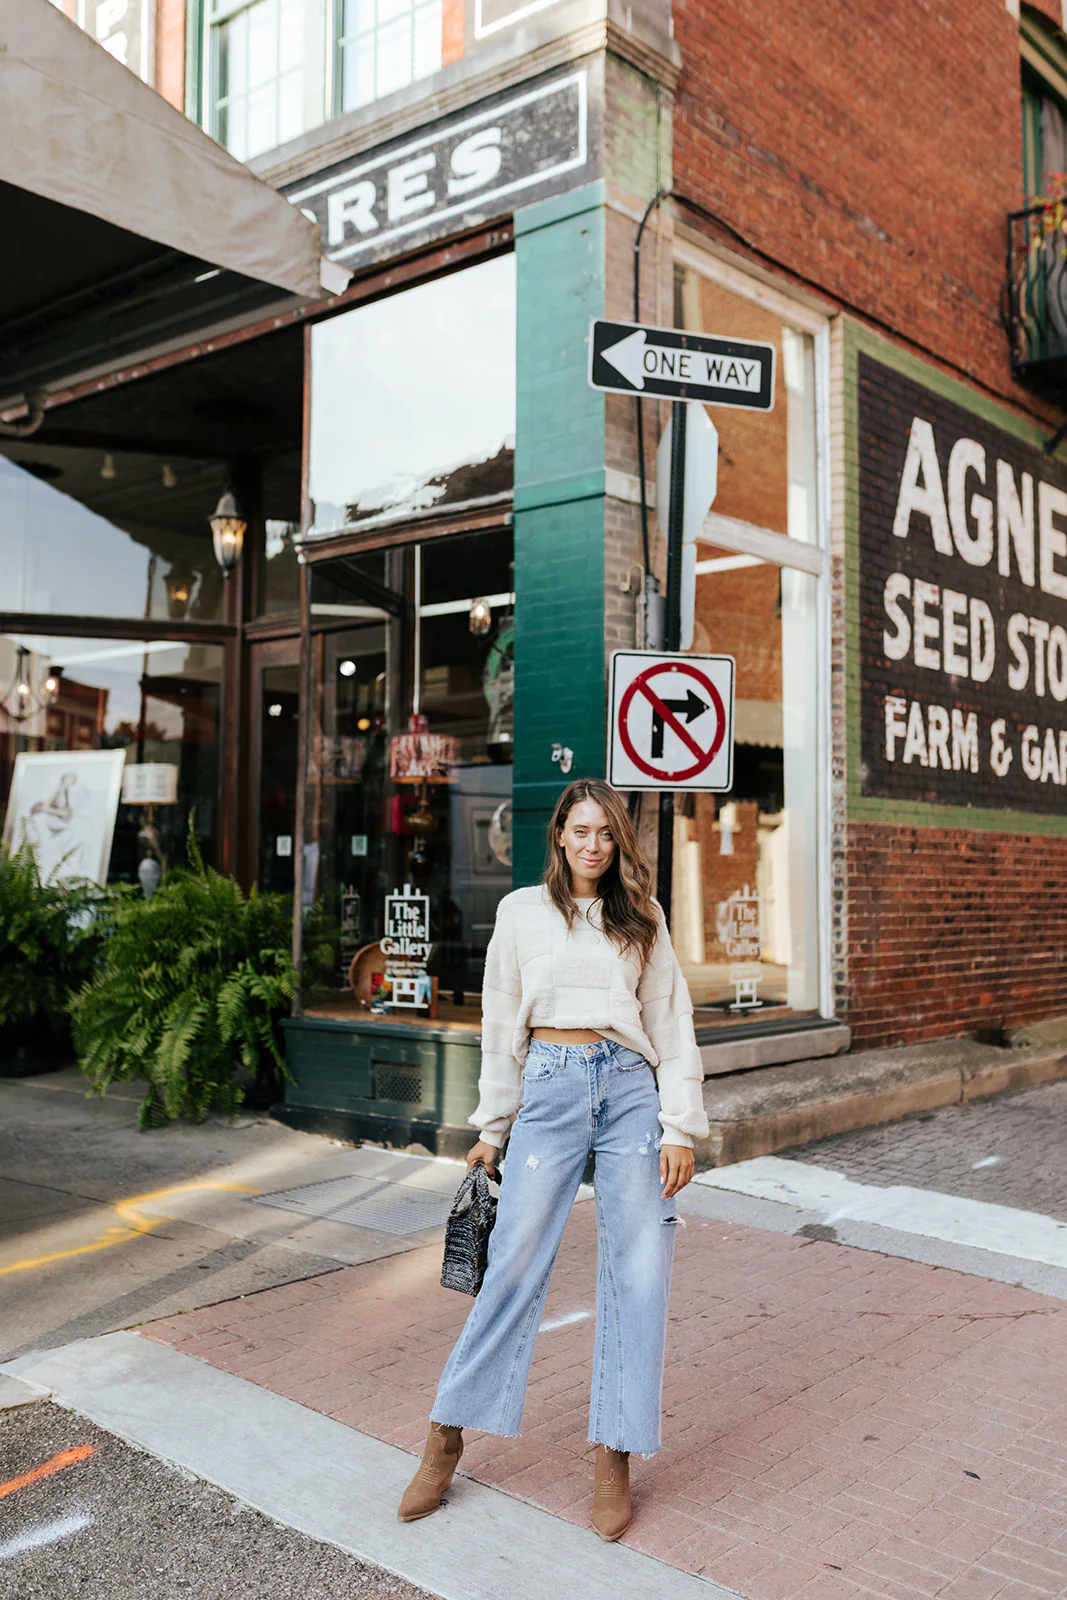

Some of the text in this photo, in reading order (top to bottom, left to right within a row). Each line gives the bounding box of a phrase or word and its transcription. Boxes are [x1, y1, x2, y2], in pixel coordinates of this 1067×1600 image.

[300, 127, 502, 246] RES
[643, 349, 755, 387] ONE WAY
[892, 416, 1067, 600] AGNE
[882, 571, 1067, 702] SEED STO
[884, 695, 978, 774] FARM
[990, 718, 1013, 777] &
[388, 920, 426, 938] Little
[392, 902, 421, 920] The
[736, 904, 757, 921] The
[379, 937, 432, 961] Gallery
